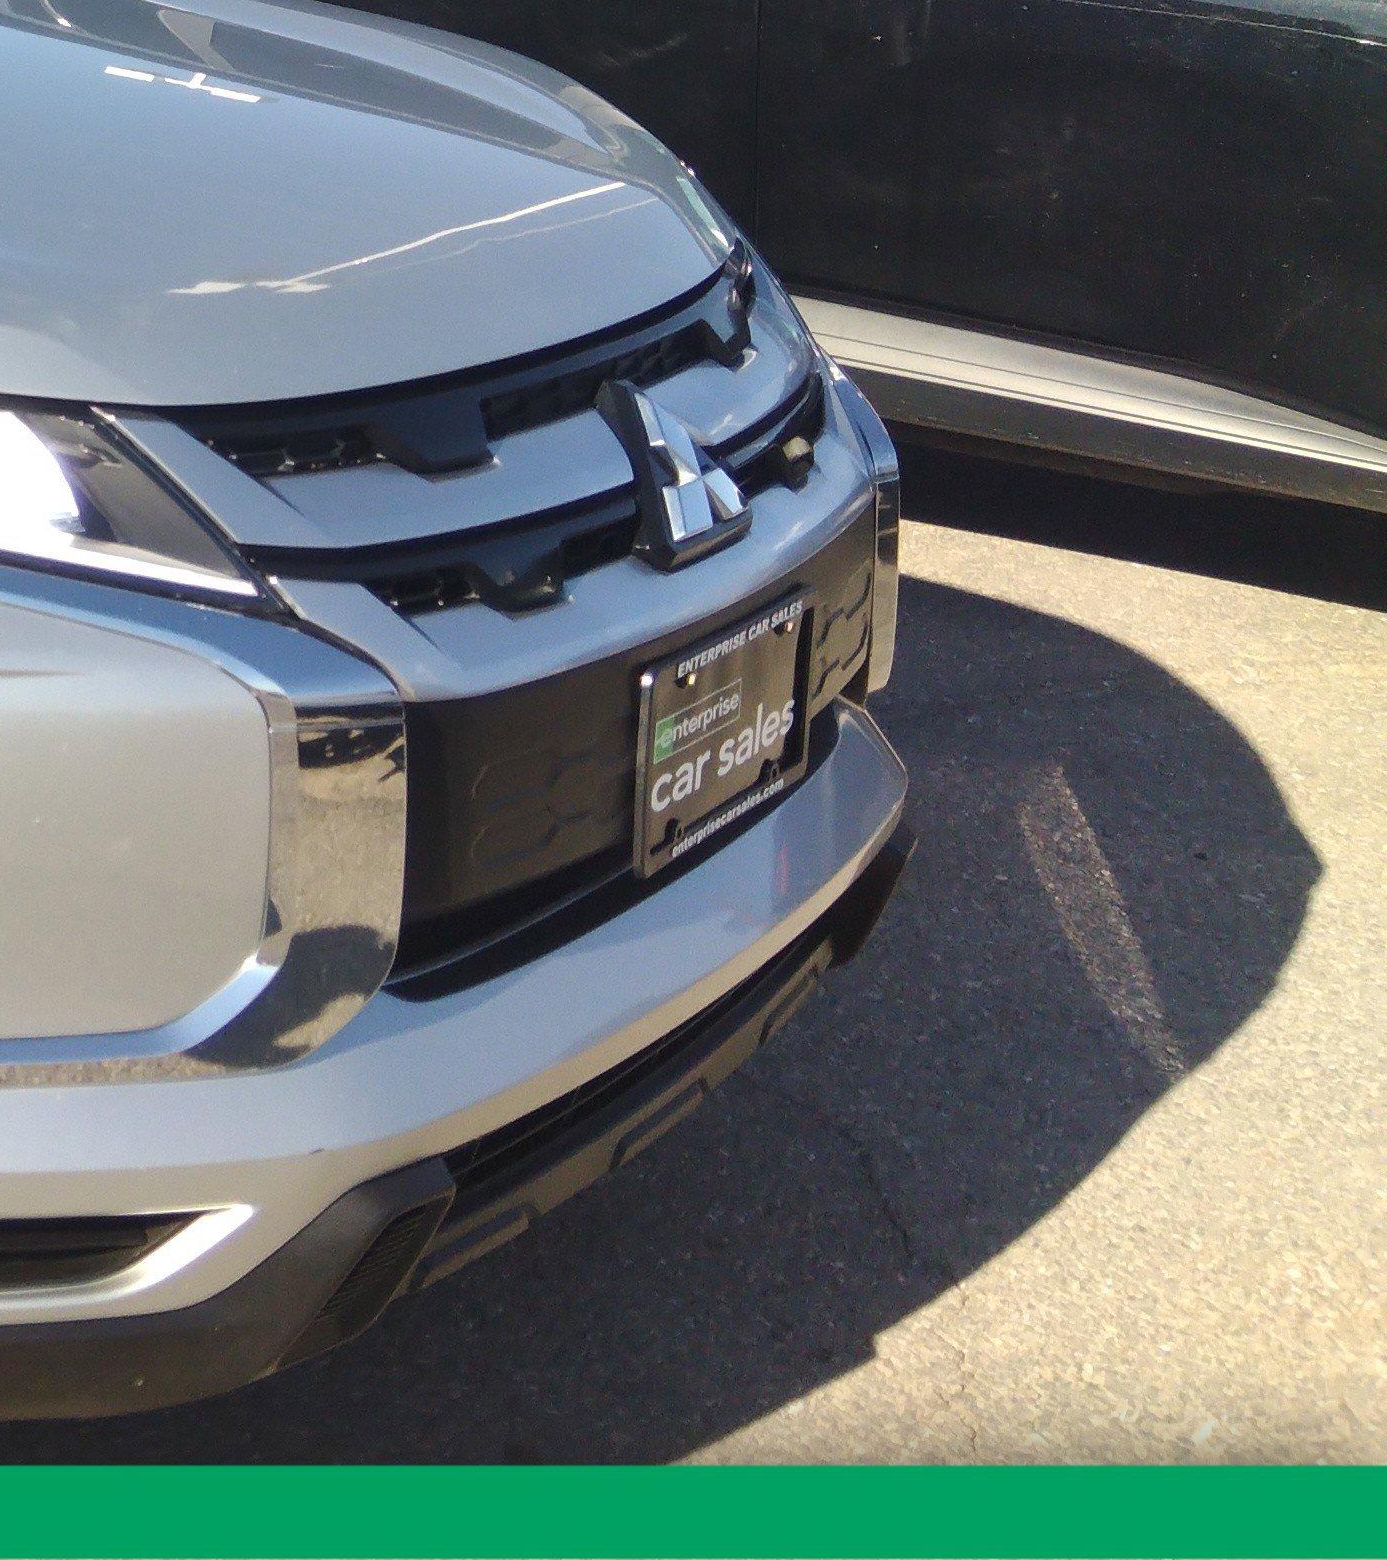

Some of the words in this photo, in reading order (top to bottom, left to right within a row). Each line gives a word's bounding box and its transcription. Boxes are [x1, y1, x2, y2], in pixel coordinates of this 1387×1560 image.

[677, 630, 747, 678] ENTERPRISE
[748, 617, 770, 641] CAR
[771, 600, 803, 629] SALES
[651, 749, 711, 812] car
[717, 699, 795, 776] sales
[658, 693, 739, 748] enterprise
[672, 778, 784, 858] enterprisecarsales.com
